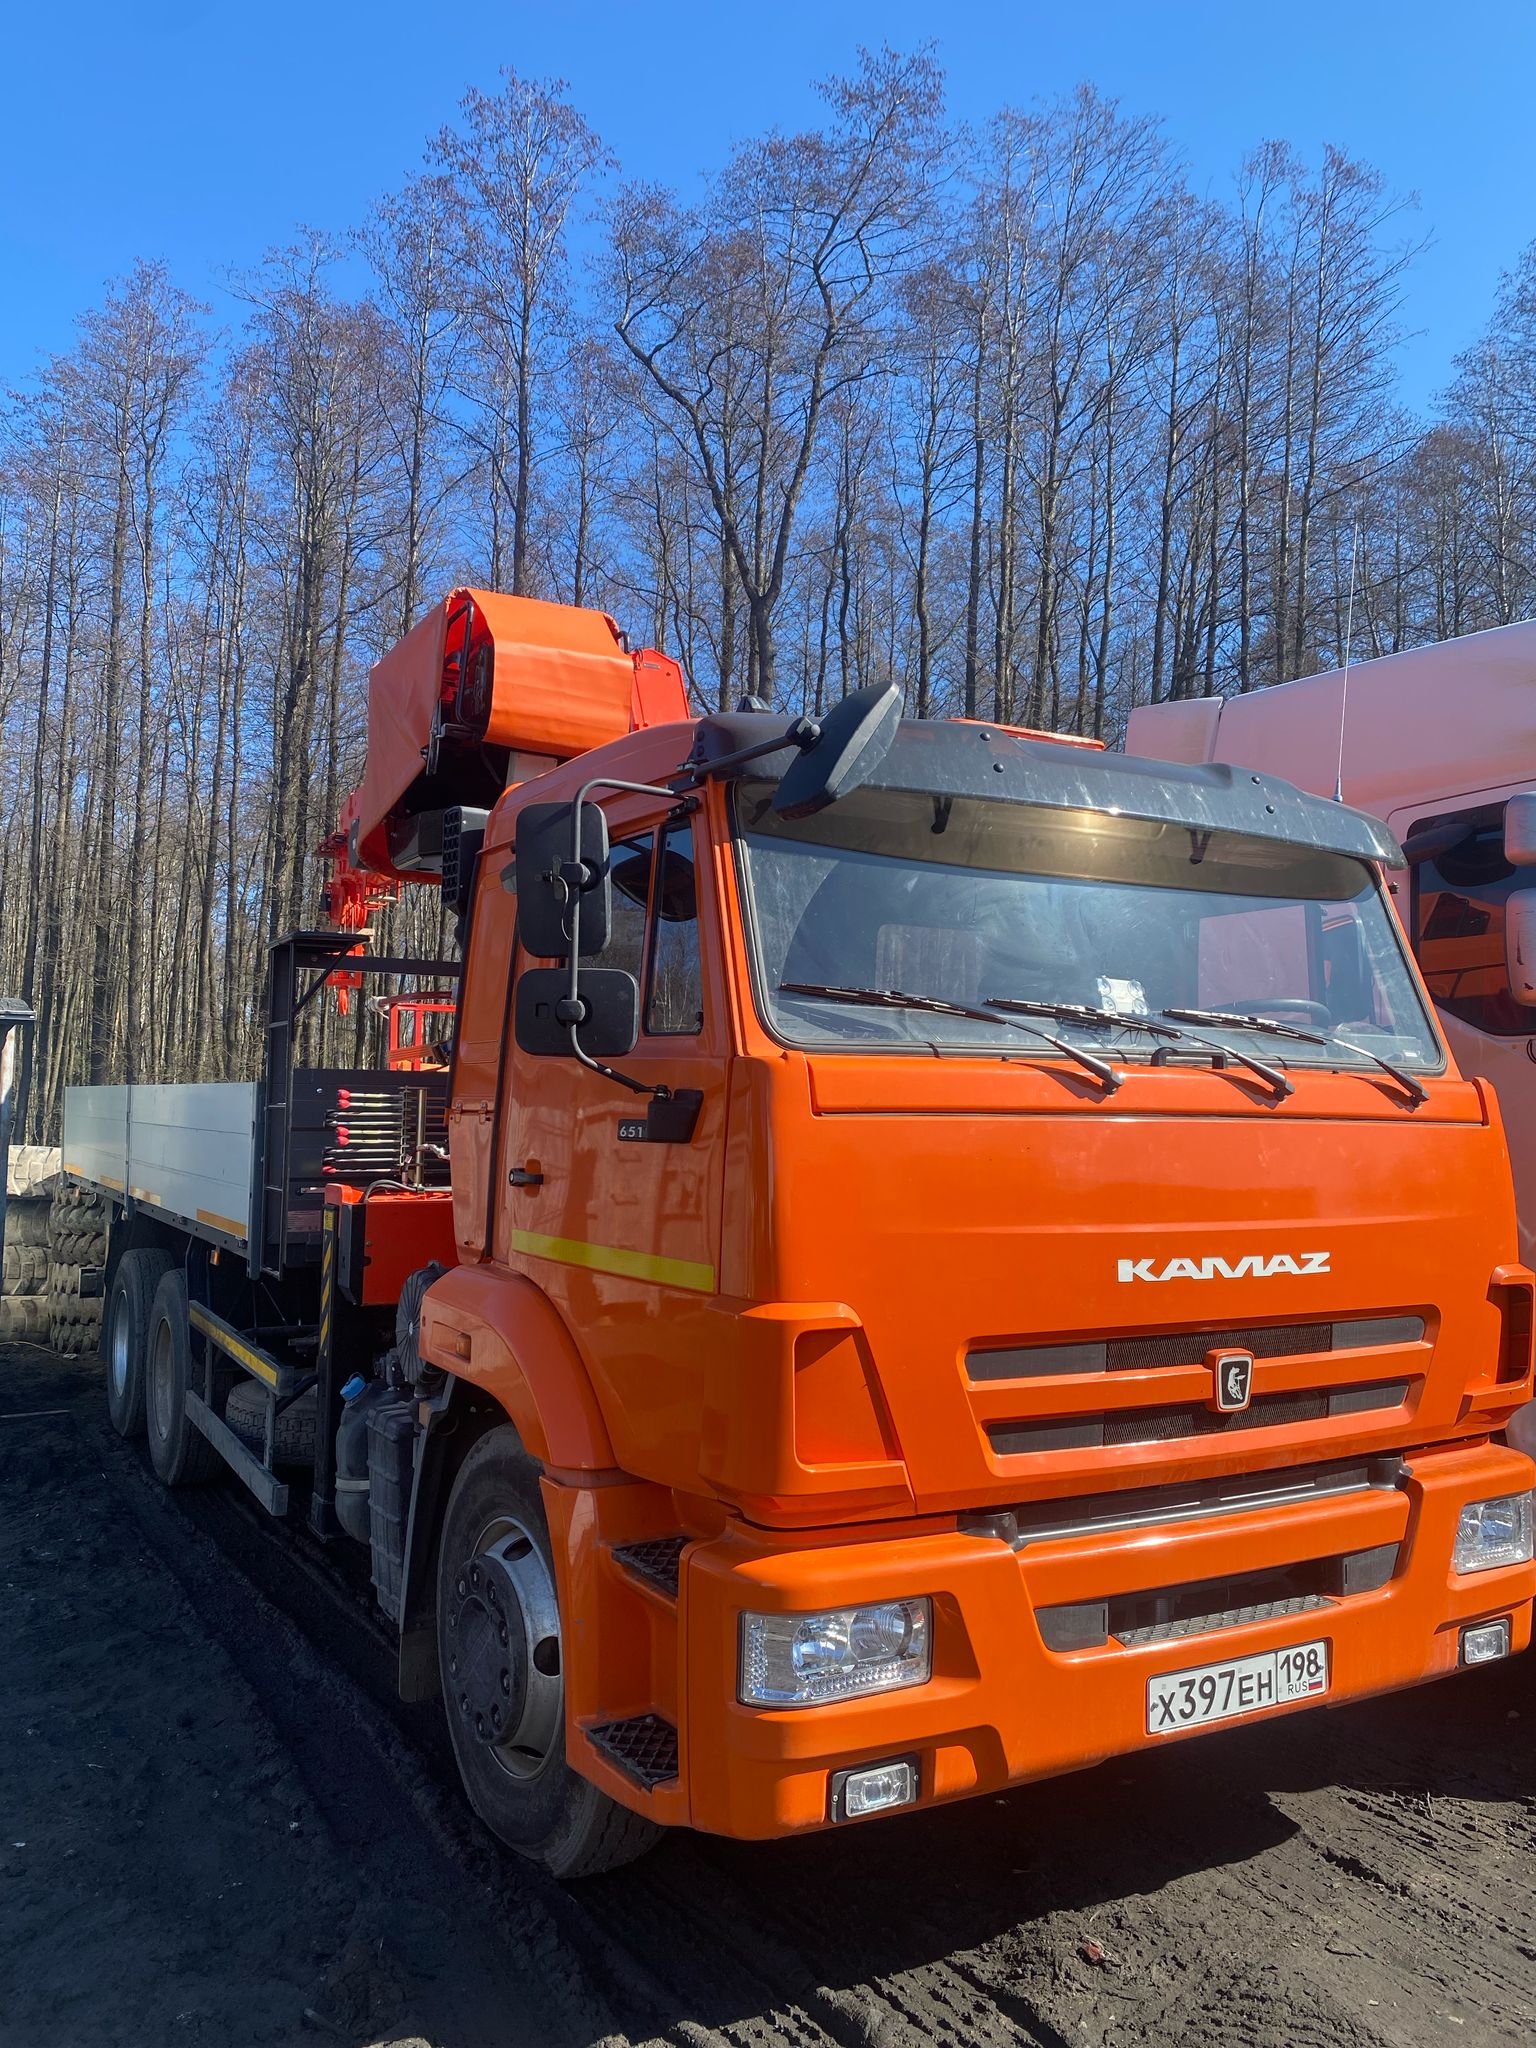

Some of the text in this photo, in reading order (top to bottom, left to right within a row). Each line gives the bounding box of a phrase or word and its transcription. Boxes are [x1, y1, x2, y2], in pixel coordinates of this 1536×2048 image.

[1117, 1251, 1331, 1283] KAMAZ
[1279, 1648, 1319, 1684] 198
[1287, 1681, 1308, 1696] RUS
